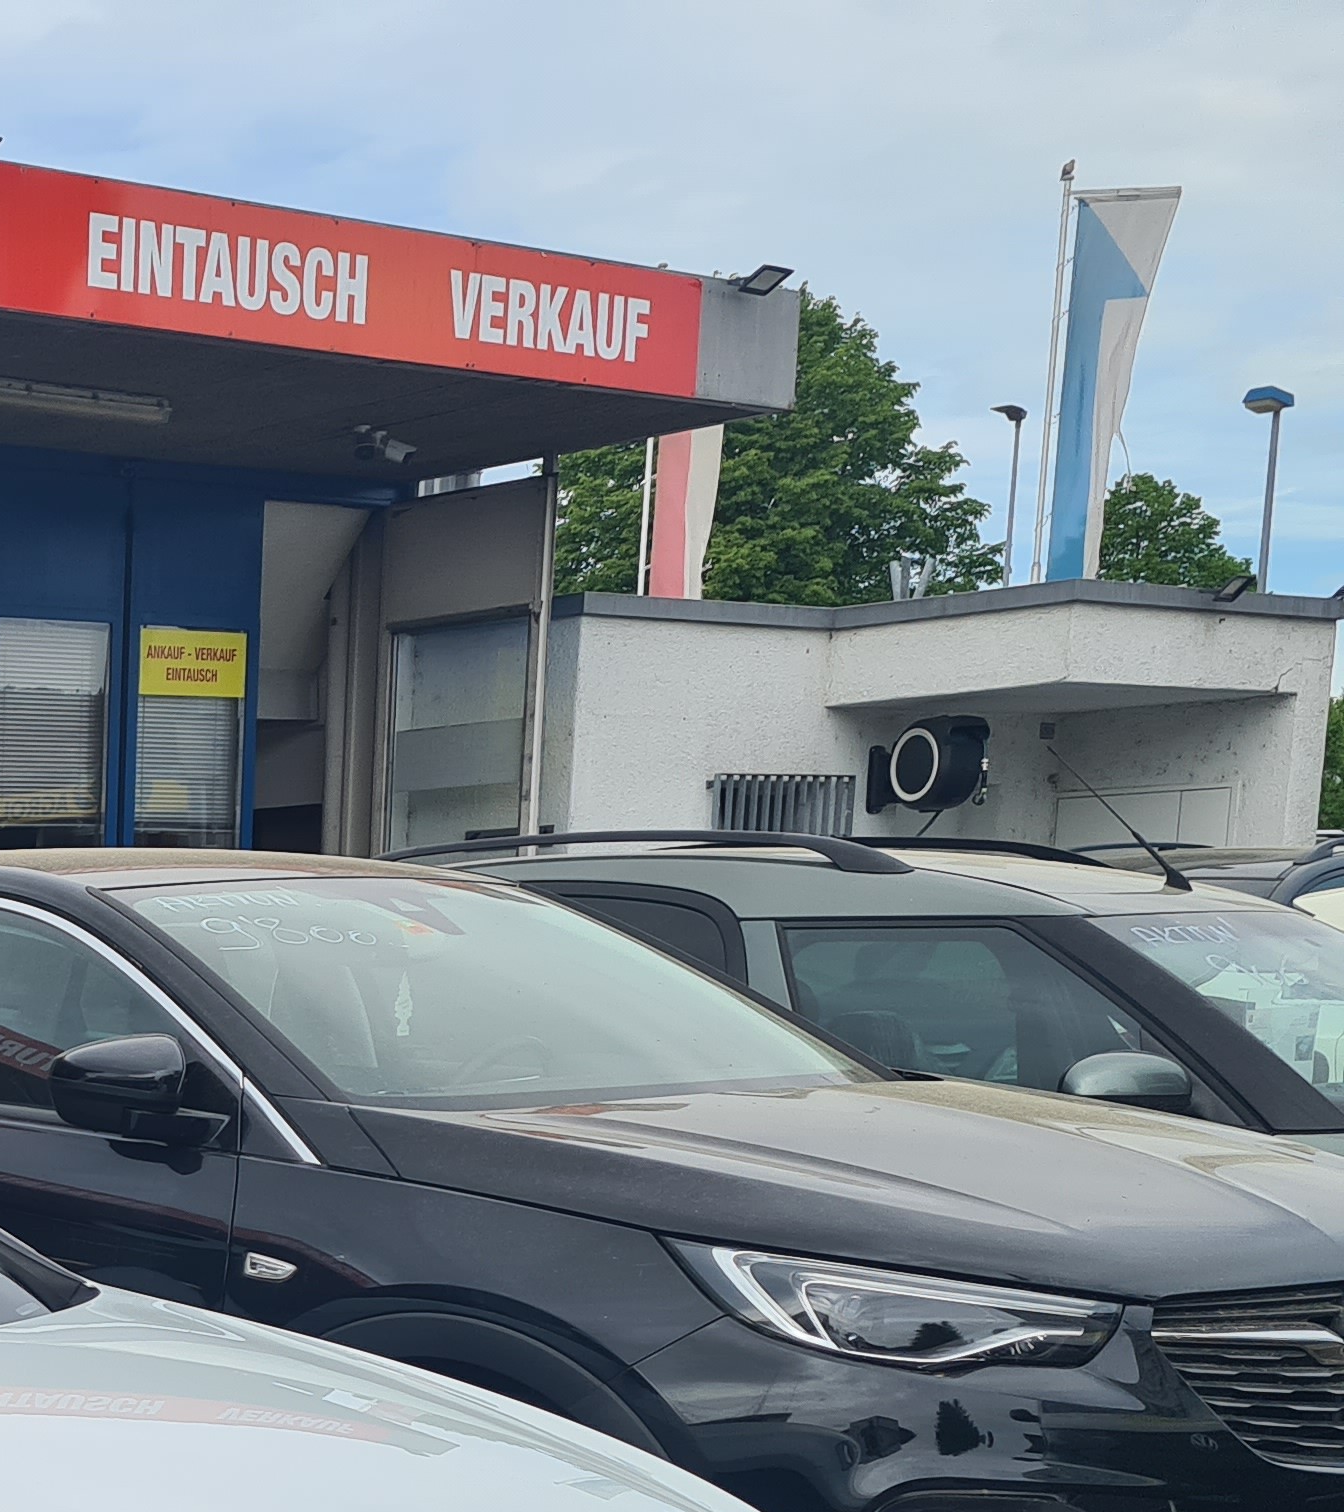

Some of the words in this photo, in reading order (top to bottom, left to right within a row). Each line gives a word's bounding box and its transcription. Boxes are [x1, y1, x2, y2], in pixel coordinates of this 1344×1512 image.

[87, 211, 367, 325] EINTAUSCH
[449, 270, 650, 362] VERKAUF
[146, 645, 185, 660] ANKAUF
[194, 646, 237, 661] VERKAUF
[166, 667, 218, 682] EINTAUSCH
